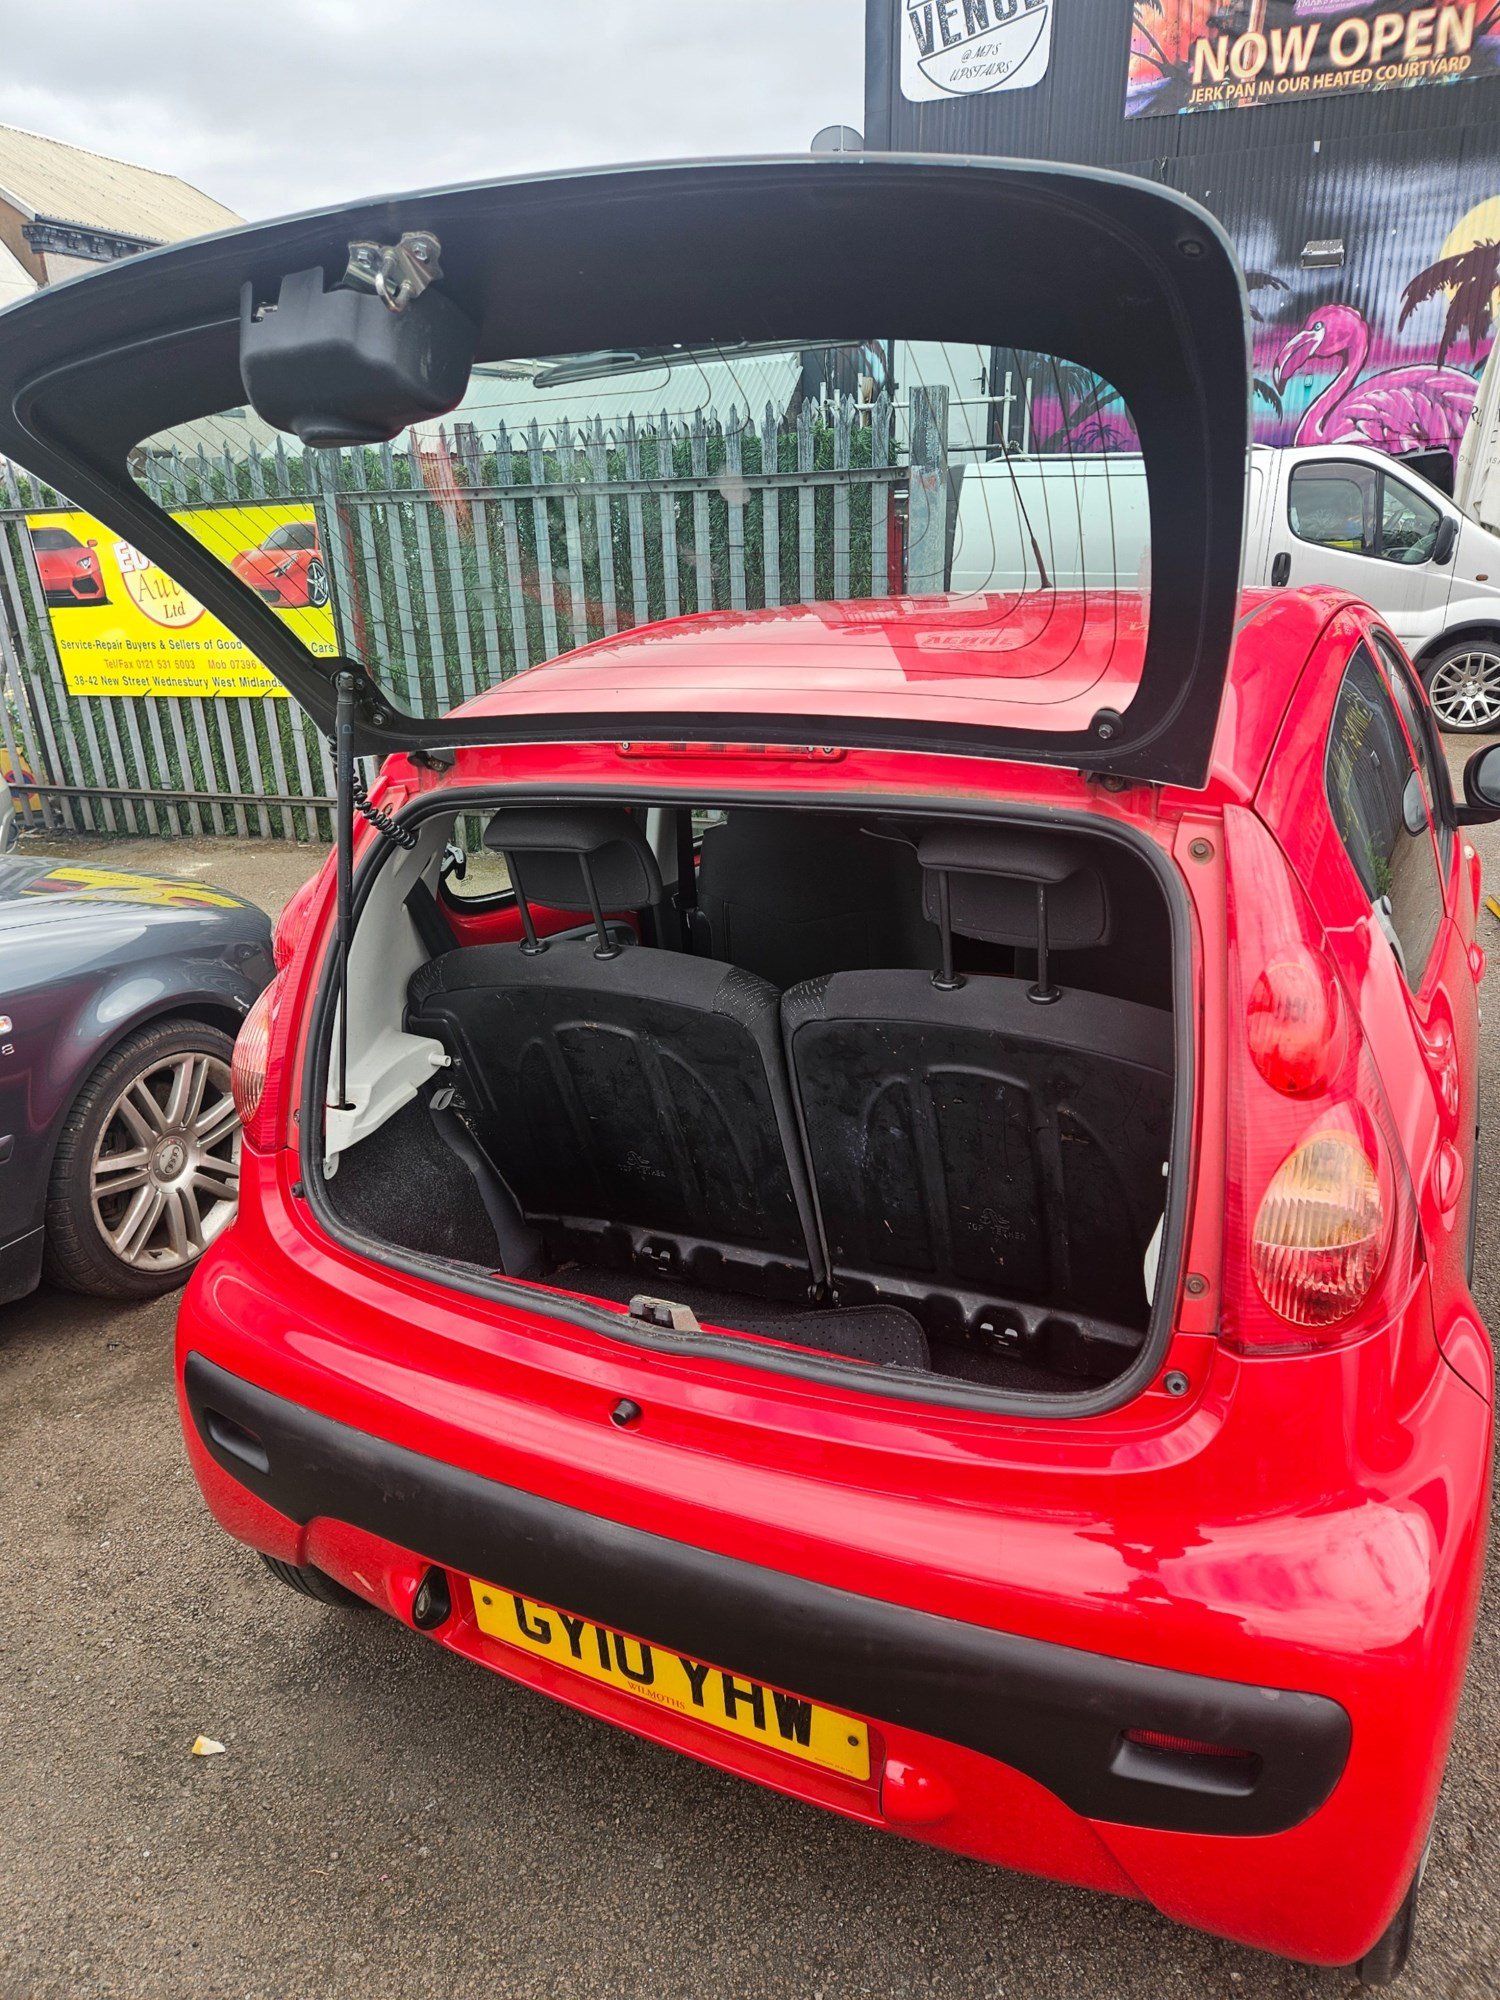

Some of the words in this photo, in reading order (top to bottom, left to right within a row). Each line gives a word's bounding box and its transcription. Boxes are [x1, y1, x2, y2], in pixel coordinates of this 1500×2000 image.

[1192, 22, 1322, 85] NOW
[1329, 2, 1477, 68] OPEN
[949, 60, 1013, 82] UPSTAIRS
[1188, 84, 1225, 104] JERK
[1226, 80, 1257, 99] PAN
[1259, 80, 1275, 96] IN
[1277, 75, 1311, 94] OUR
[1312, 67, 1373, 90] HEATED
[1375, 54, 1472, 81] COURTYARD
[163, 601, 187, 619] Ltd
[60, 639, 123, 652] Service-Repair
[126, 639, 157, 652] Buyers
[159, 640, 166, 650] &
[168, 639, 200, 651] Sellers
[203, 640, 214, 650] of
[216, 639, 243, 650] Good
[310, 642, 335, 653] Cars
[104, 658, 134, 670] Tel/Fax
[136, 659, 154, 670] 0121
[157, 659, 171, 670] 531
[174, 659, 196, 670] 5003
[208, 659, 227, 670] Mob
[230, 659, 257, 670] 07396
[73, 675, 99, 686] 38-42
[101, 675, 119, 686] New
[122, 675, 151, 687] Street
[152, 675, 209, 690] Wednesbury
[211, 676, 237, 688] West
[513, 1595, 655, 1686] GY10
[678, 1656, 813, 1748] YHW
[626, 1680, 686, 1711] WILMOTHS
